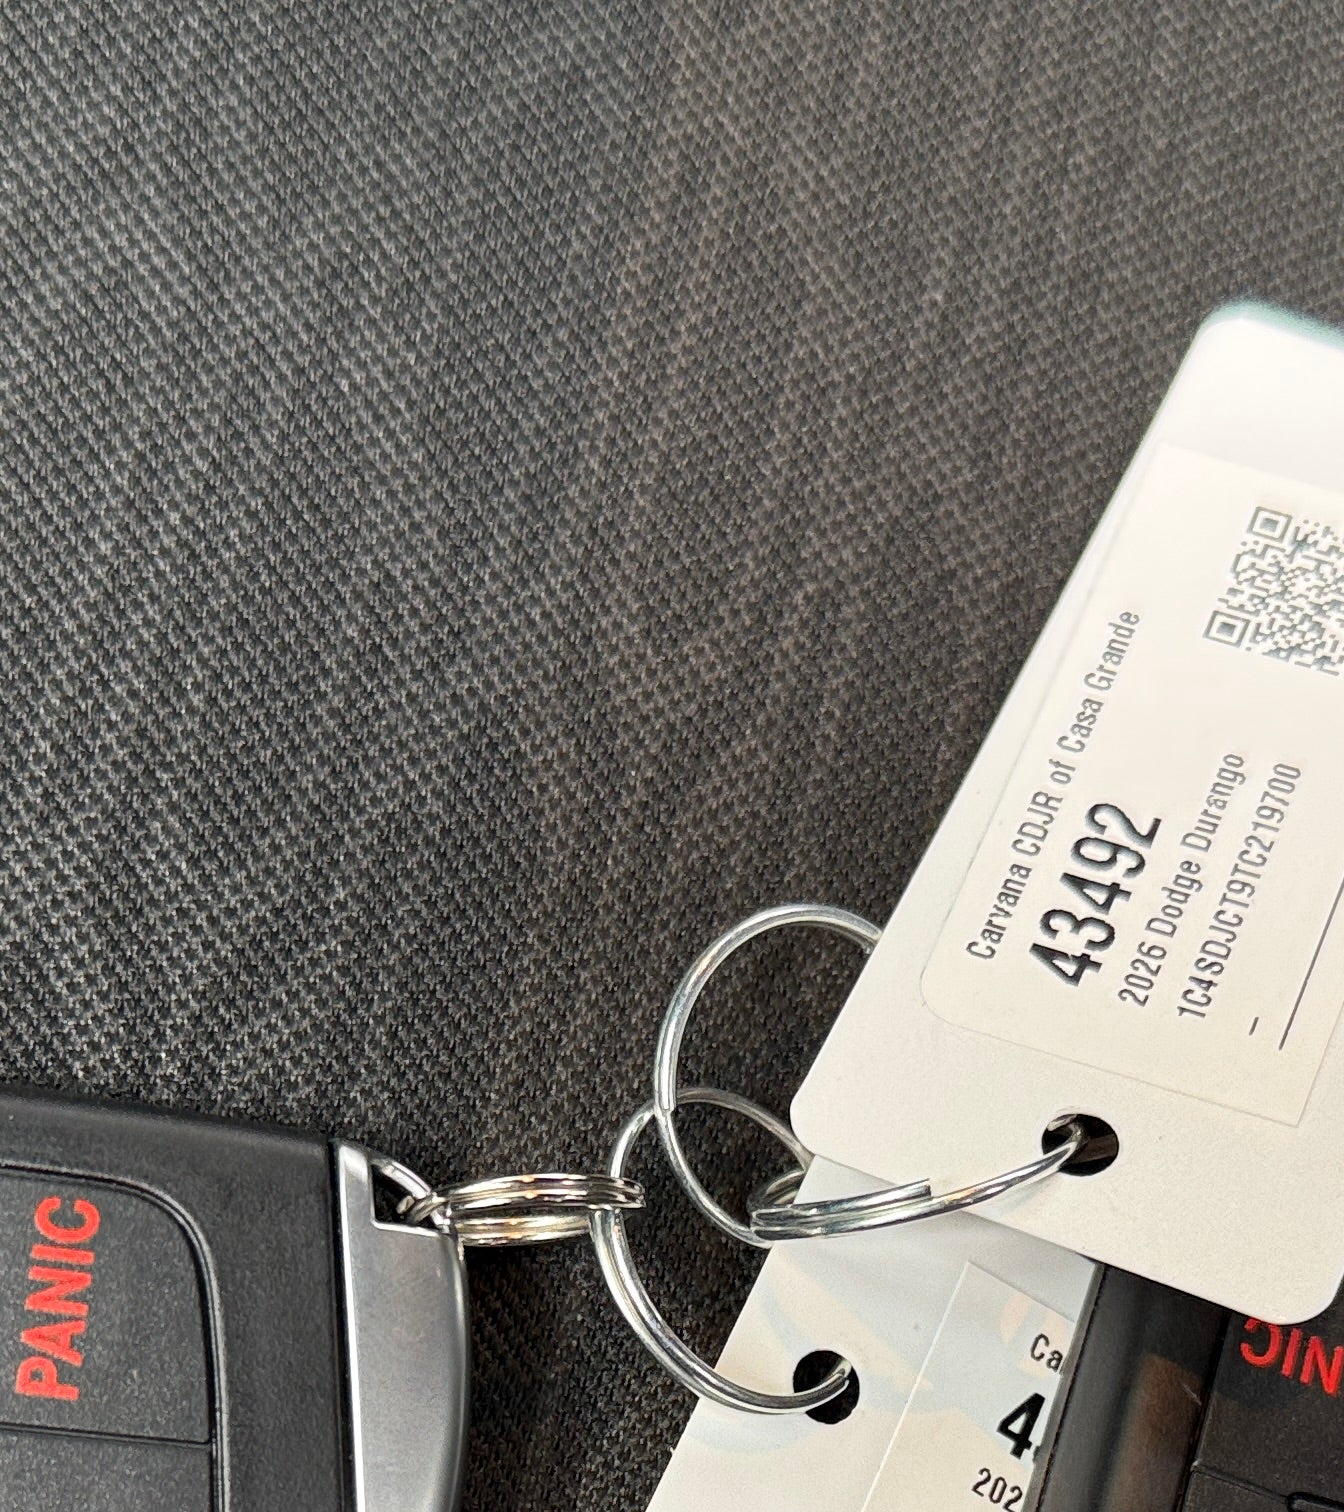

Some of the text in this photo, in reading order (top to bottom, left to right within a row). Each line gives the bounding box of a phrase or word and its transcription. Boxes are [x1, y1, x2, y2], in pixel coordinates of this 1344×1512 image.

[966, 610, 1140, 960] Carvana CDJR of Casa Grande
[1029, 803, 1162, 987] 43492
[1118, 753, 1246, 1007] 2026 Dodge Durango
[1177, 763, 1301, 1018] 1C4SDJCT9TC219700
[15, 1196, 101, 1401] PANIC
[996, 1392, 1042, 1464] 4
